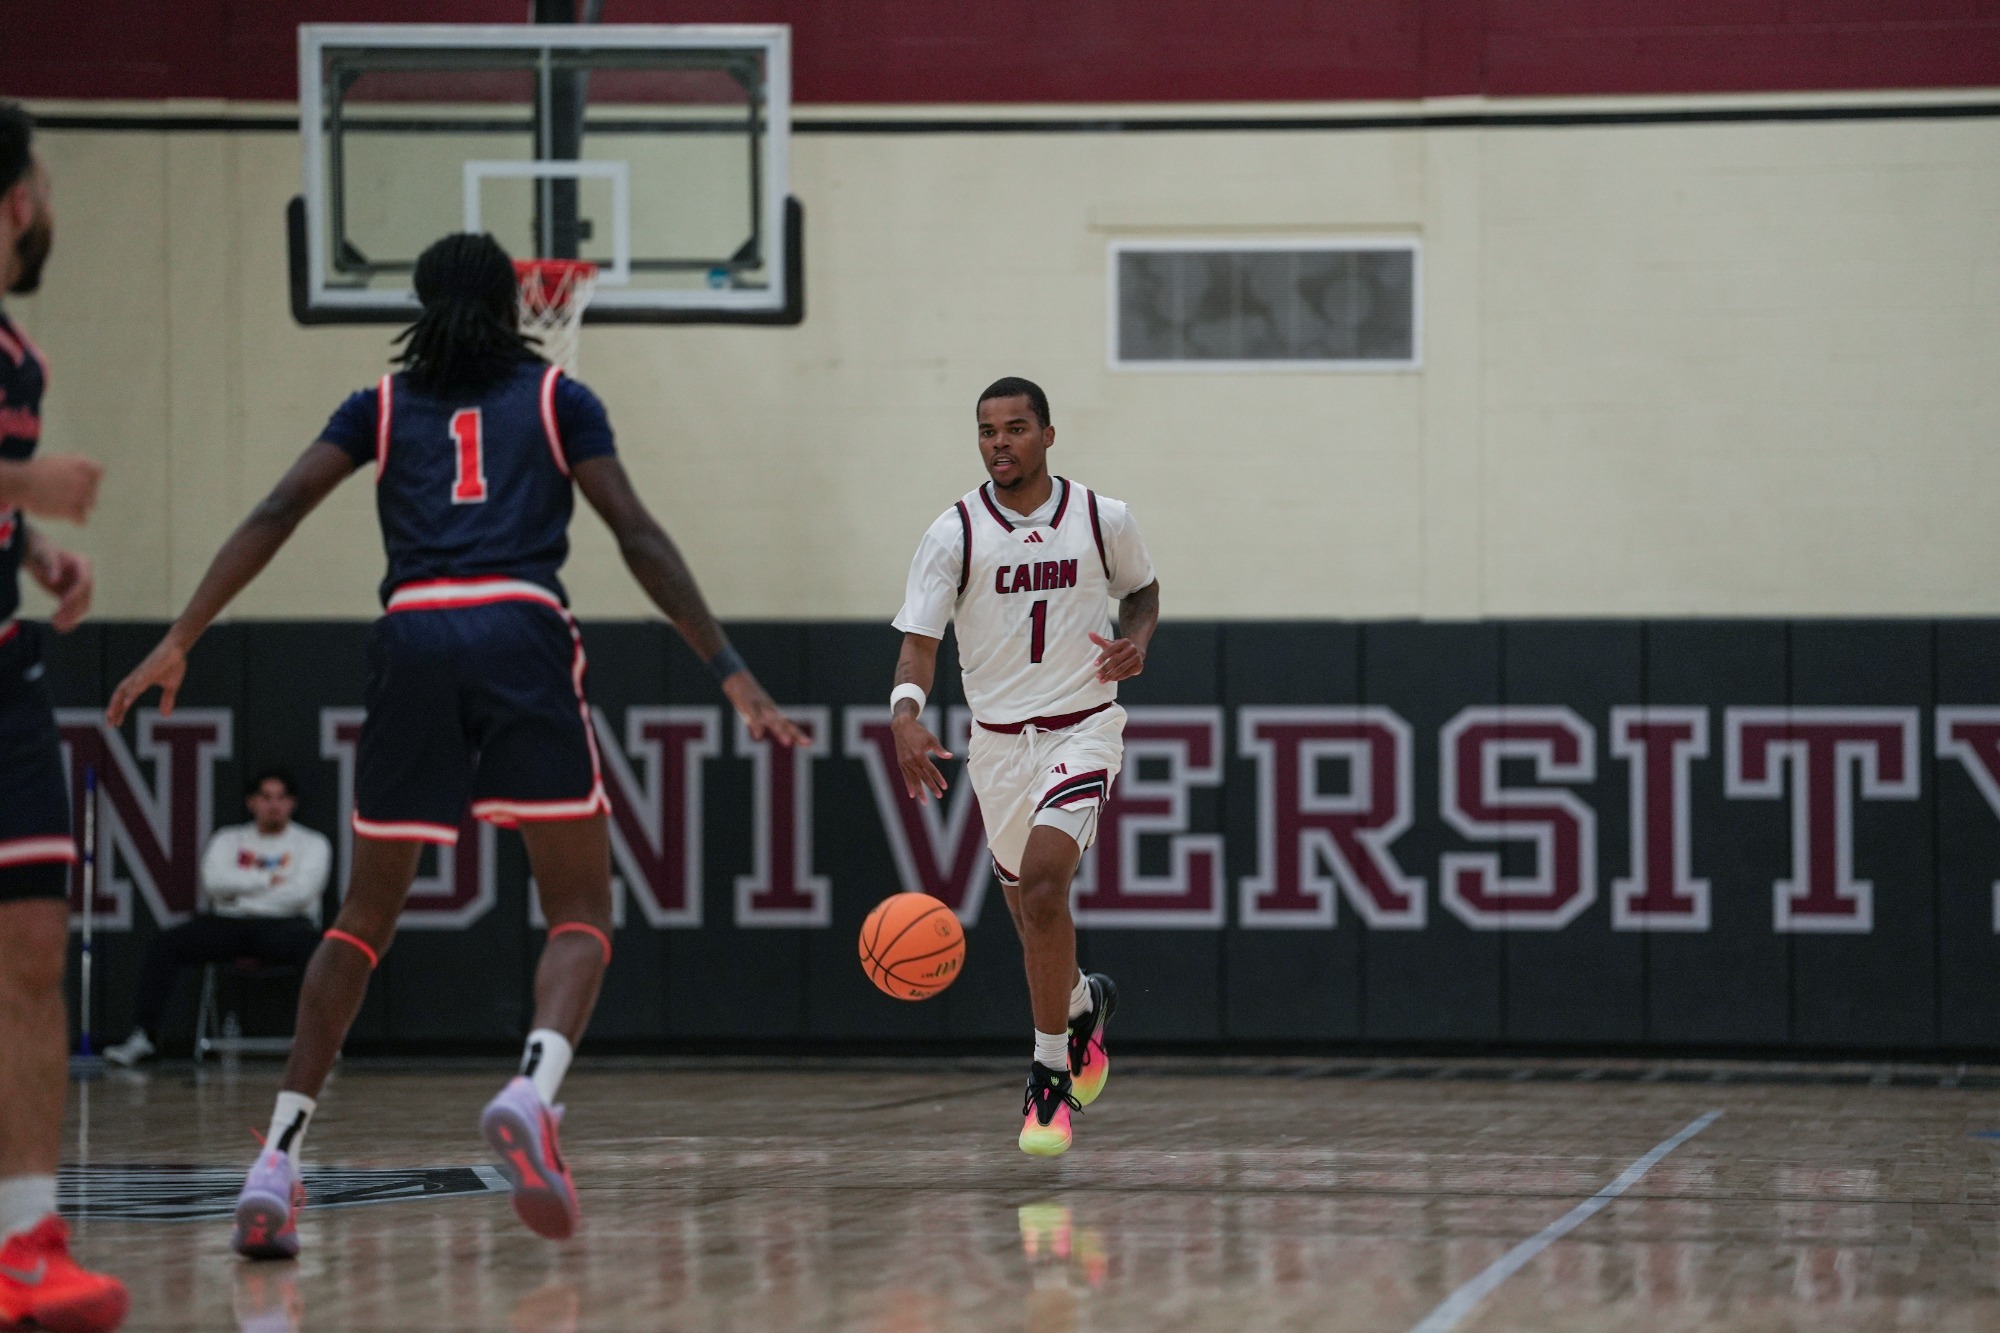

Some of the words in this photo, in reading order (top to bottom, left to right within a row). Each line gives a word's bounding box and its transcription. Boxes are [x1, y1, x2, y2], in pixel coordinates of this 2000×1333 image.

[448, 406, 488, 504] 1
[995, 558, 1078, 595] CAIRN
[1029, 599, 1048, 664] 1
